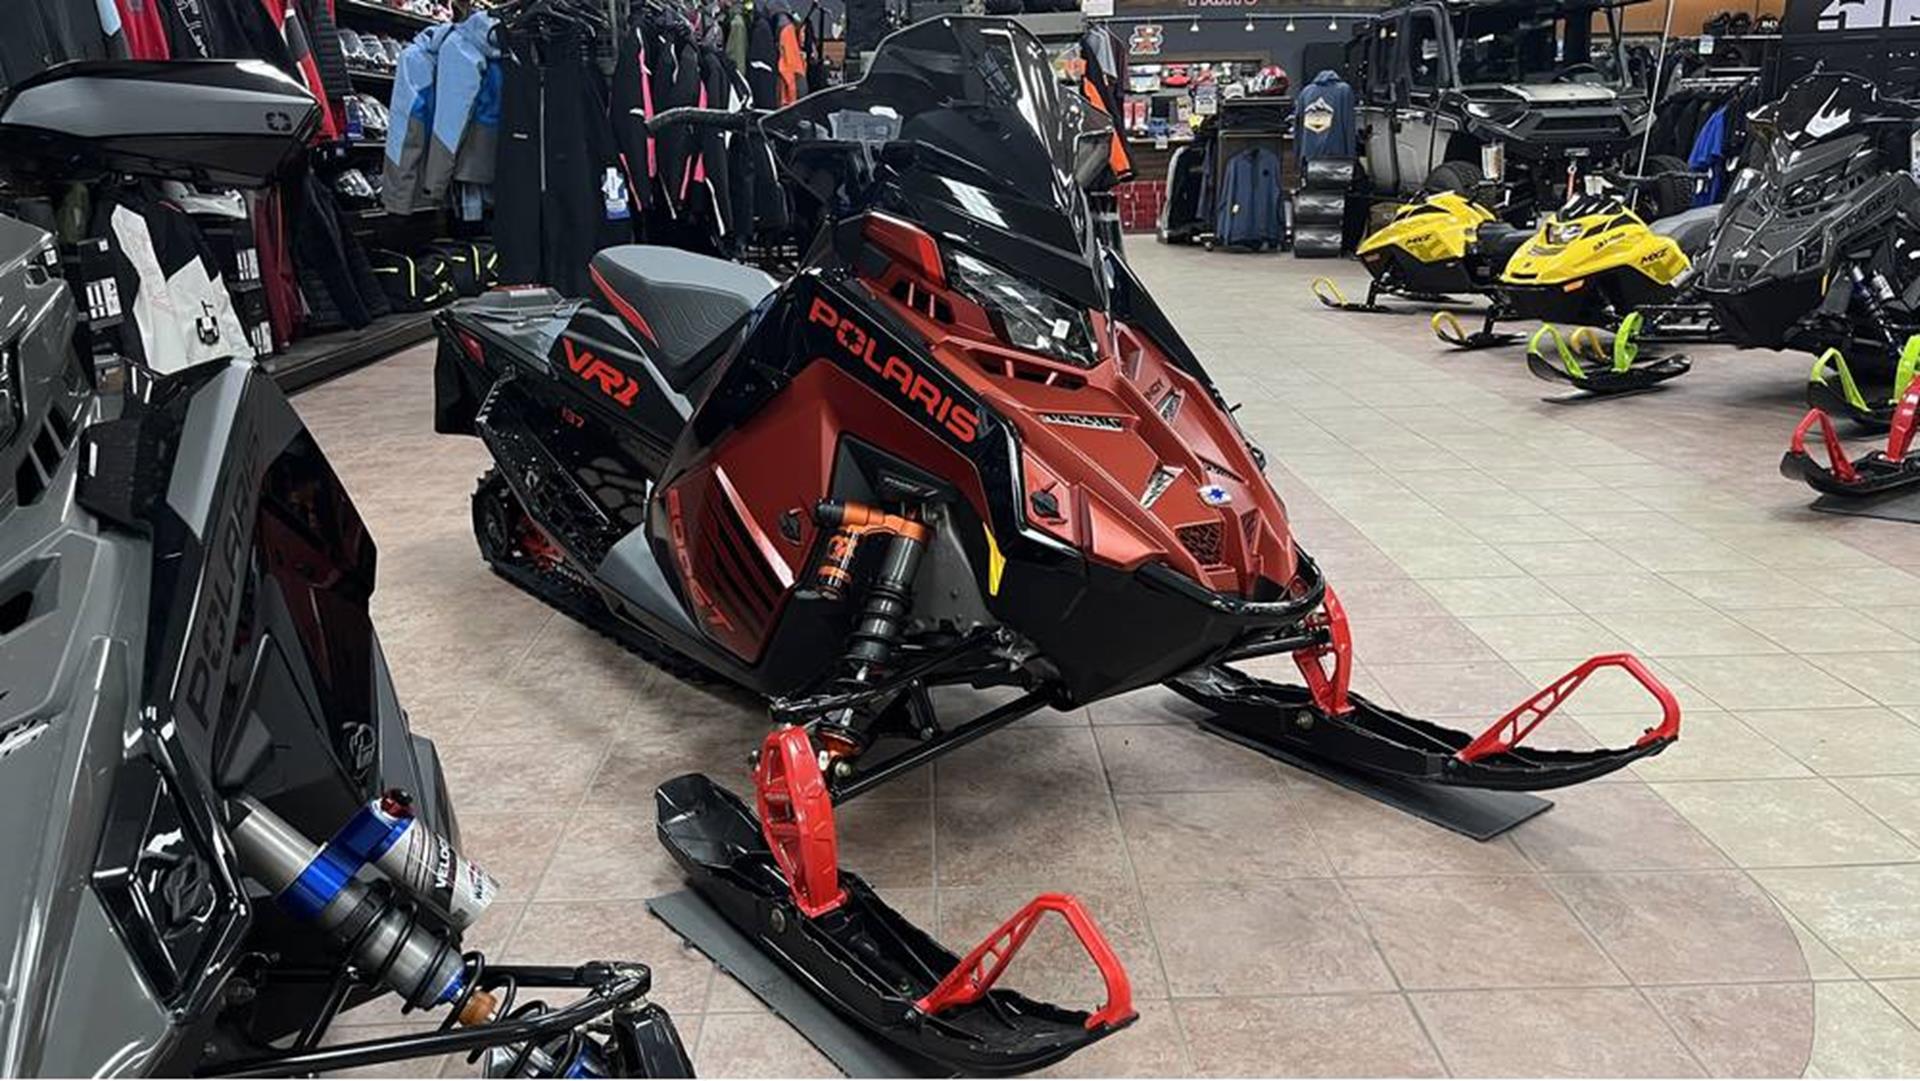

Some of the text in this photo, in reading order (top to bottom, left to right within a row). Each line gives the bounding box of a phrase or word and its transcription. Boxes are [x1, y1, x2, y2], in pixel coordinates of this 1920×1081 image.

[562, 336, 639, 406] VR1
[808, 296, 981, 443] POLARIS
[186, 430, 260, 733] POLARIS
